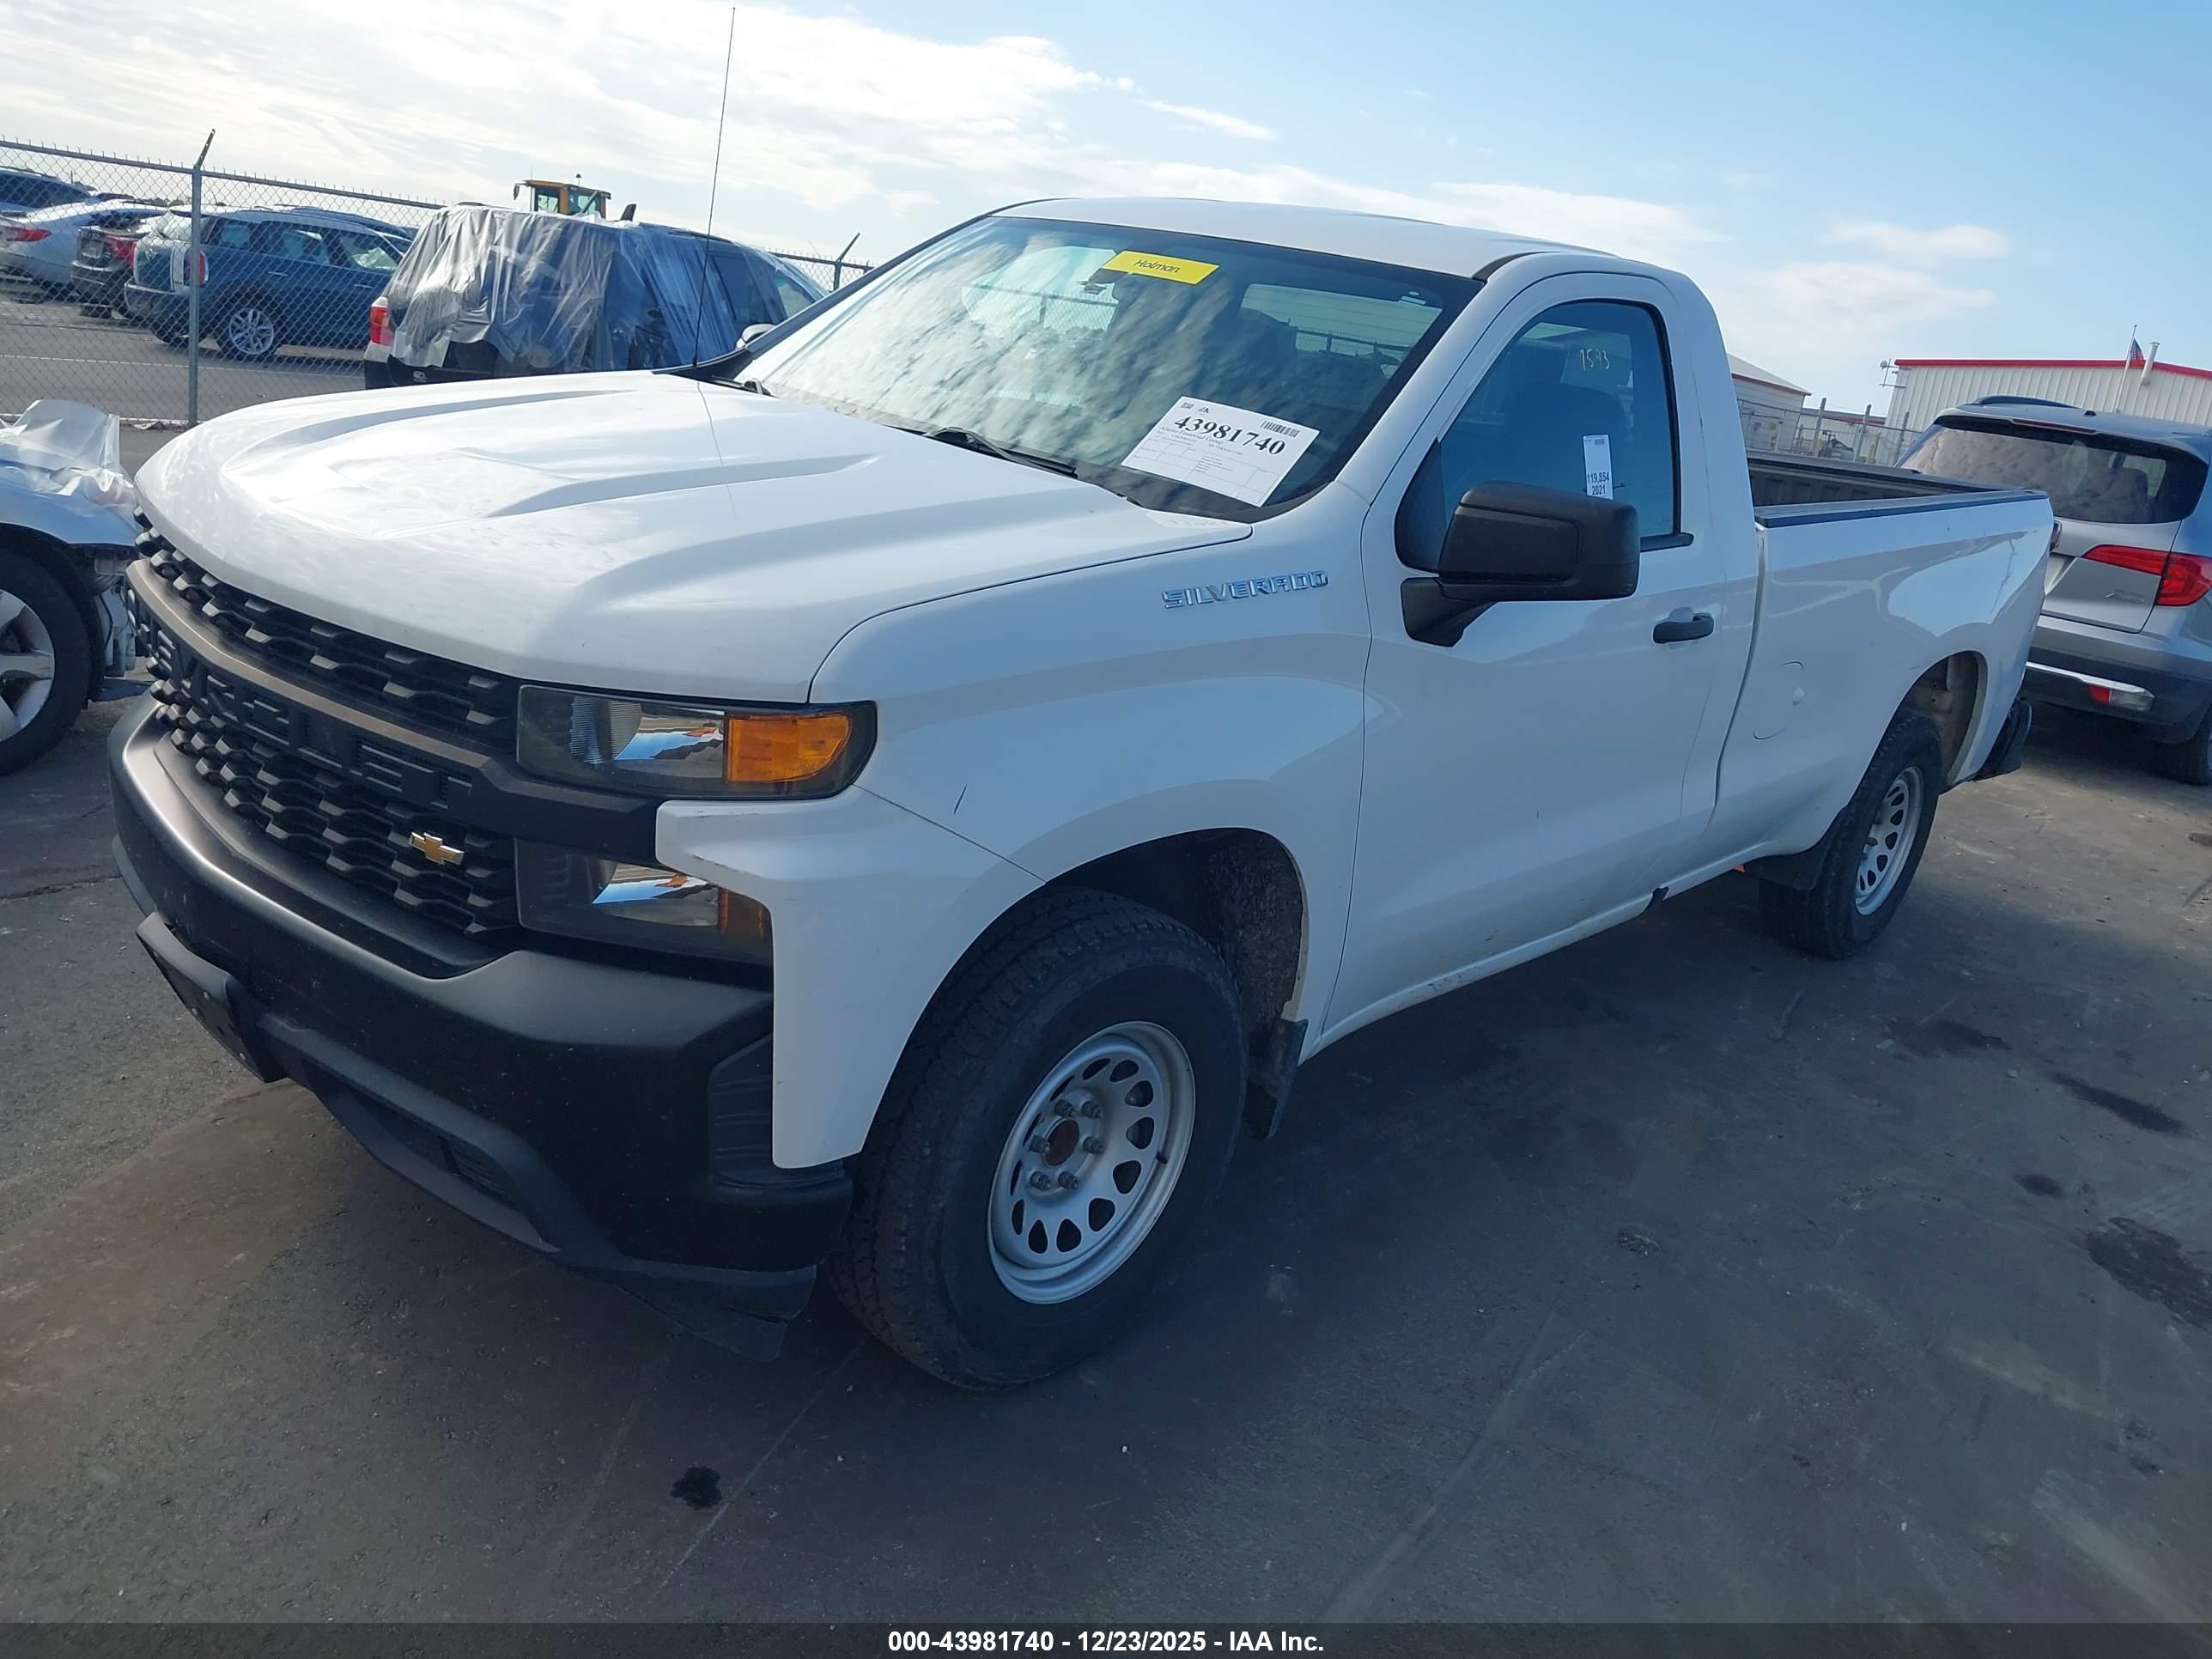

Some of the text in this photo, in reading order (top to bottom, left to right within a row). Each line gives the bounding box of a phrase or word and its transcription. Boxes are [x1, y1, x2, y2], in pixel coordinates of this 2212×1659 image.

[1133, 258, 1181, 273] Holman
[1174, 416, 1286, 455] 43981740
[1587, 471, 1610, 483] 119,854
[1592, 484, 1606, 495] 2021
[1162, 571, 1328, 609] SILVERADO
